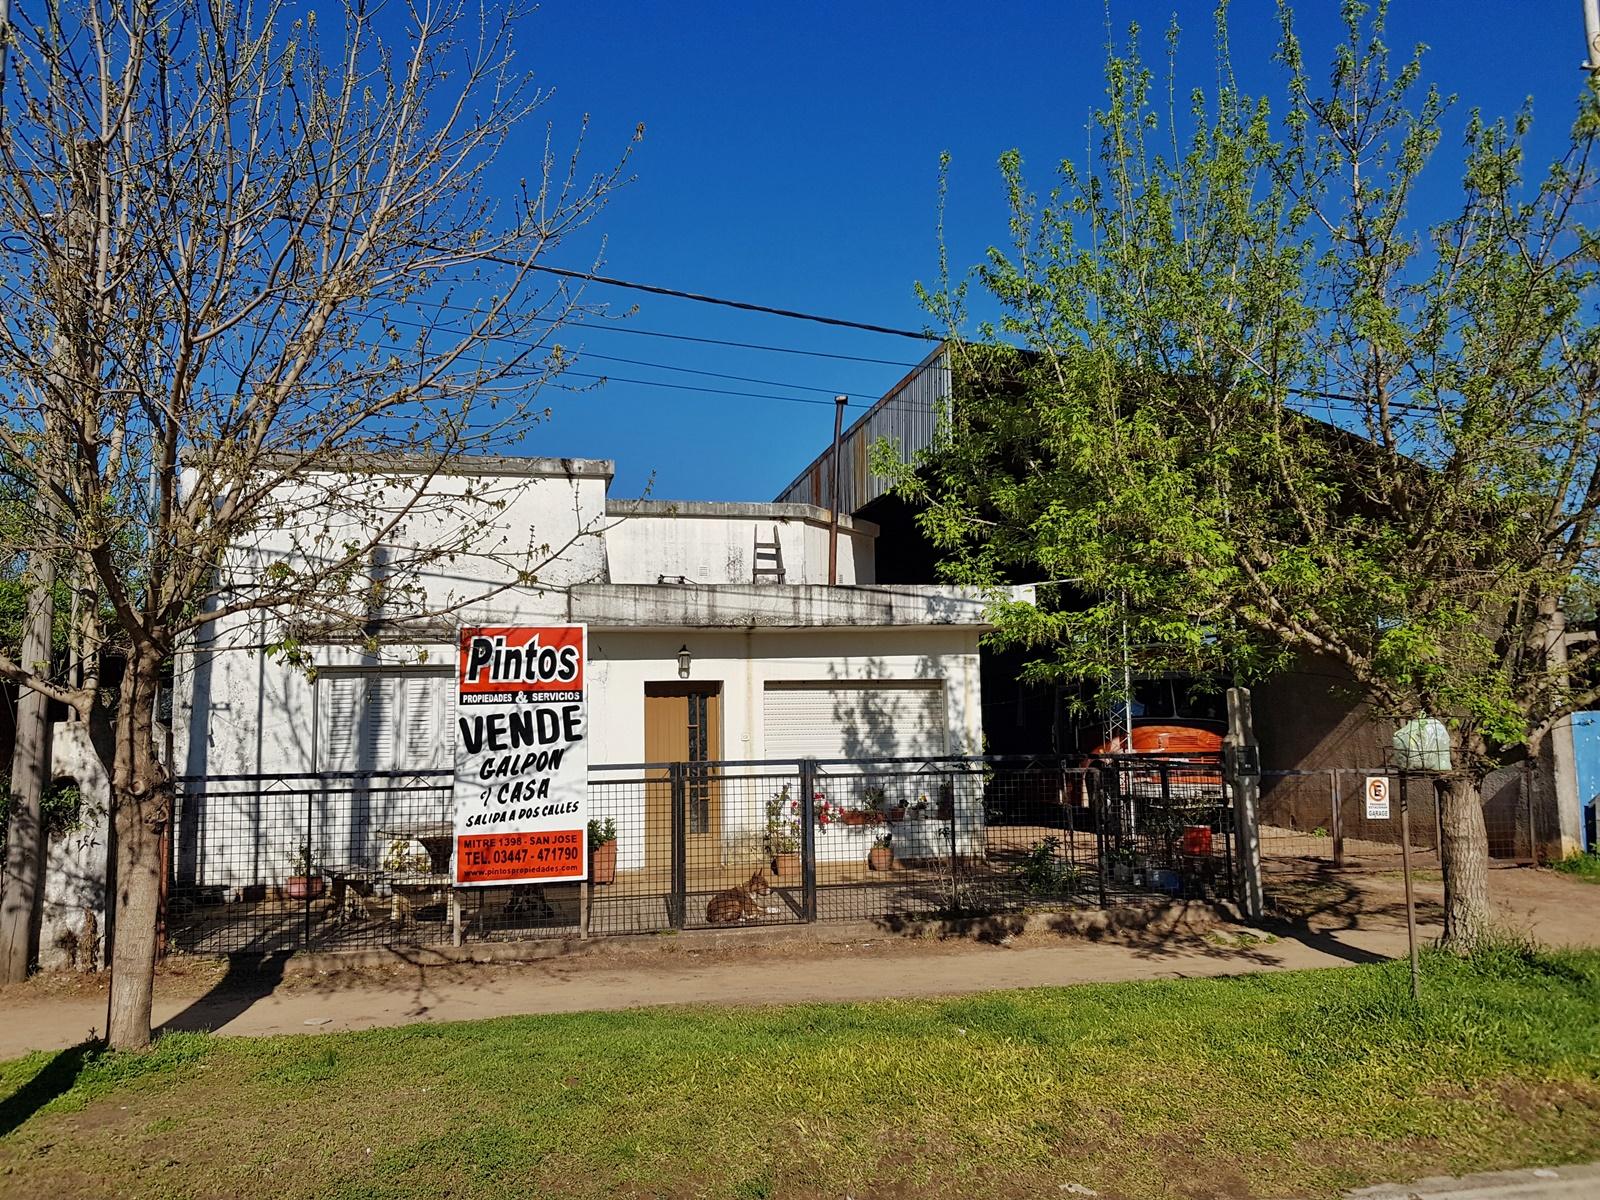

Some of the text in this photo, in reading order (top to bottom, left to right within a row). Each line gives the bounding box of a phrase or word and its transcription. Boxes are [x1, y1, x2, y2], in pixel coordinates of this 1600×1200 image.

[465, 634, 579, 683] Pintos
[462, 690, 580, 704] PROPIEDADES & SERVICIOS
[459, 705, 583, 754] VENDE
[479, 748, 565, 780] GALPON
[497, 777, 550, 805] CASA
[465, 801, 580, 827] SALIDA A DOS CALLES
[463, 838, 496, 849] MITRE
[499, 836, 522, 847] 1398
[529, 835, 550, 846] SAN
[551, 834, 577, 844] JOSE
[465, 850, 491, 866] TEL.
[493, 848, 528, 864] 03447
[537, 846, 578, 862] 471790
[463, 864, 578, 877] www.pintospropiedades.com
